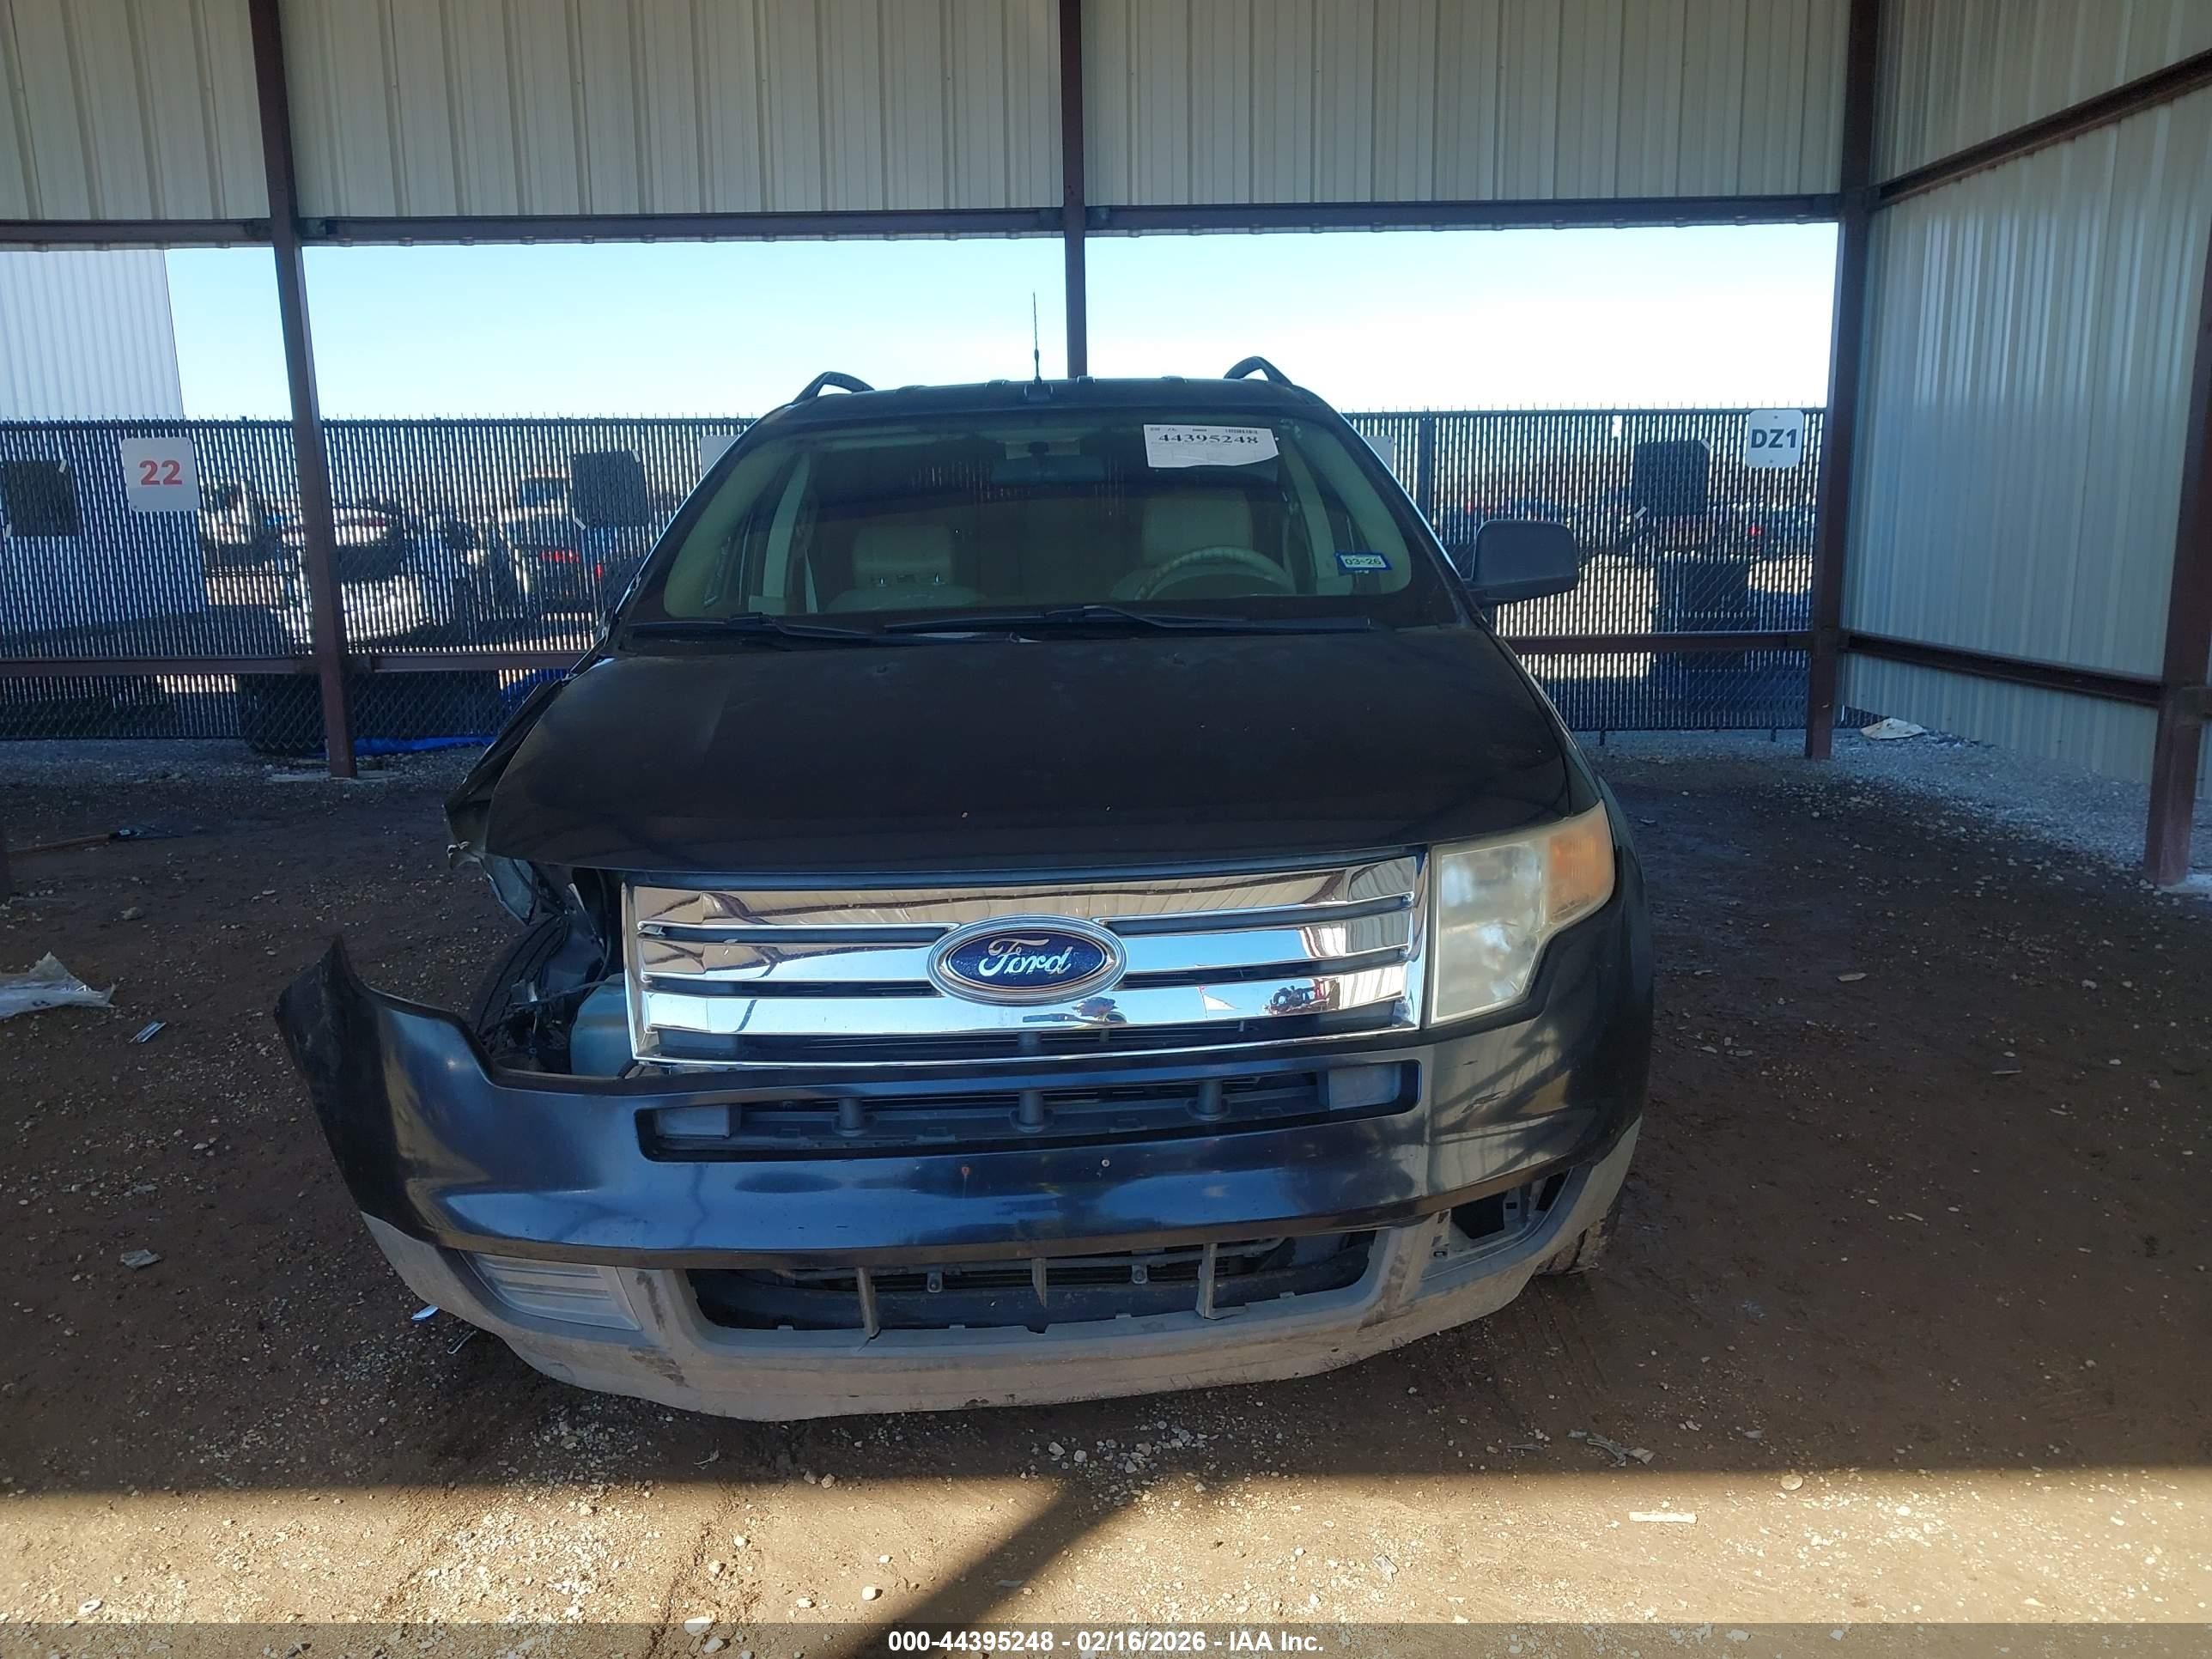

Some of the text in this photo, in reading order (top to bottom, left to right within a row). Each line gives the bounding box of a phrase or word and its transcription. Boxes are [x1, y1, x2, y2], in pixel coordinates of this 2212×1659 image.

[1158, 433, 1259, 444] 44395248
[1751, 428, 1797, 449] DZ1
[139, 459, 183, 486] 22
[978, 938, 1073, 976] Ford
